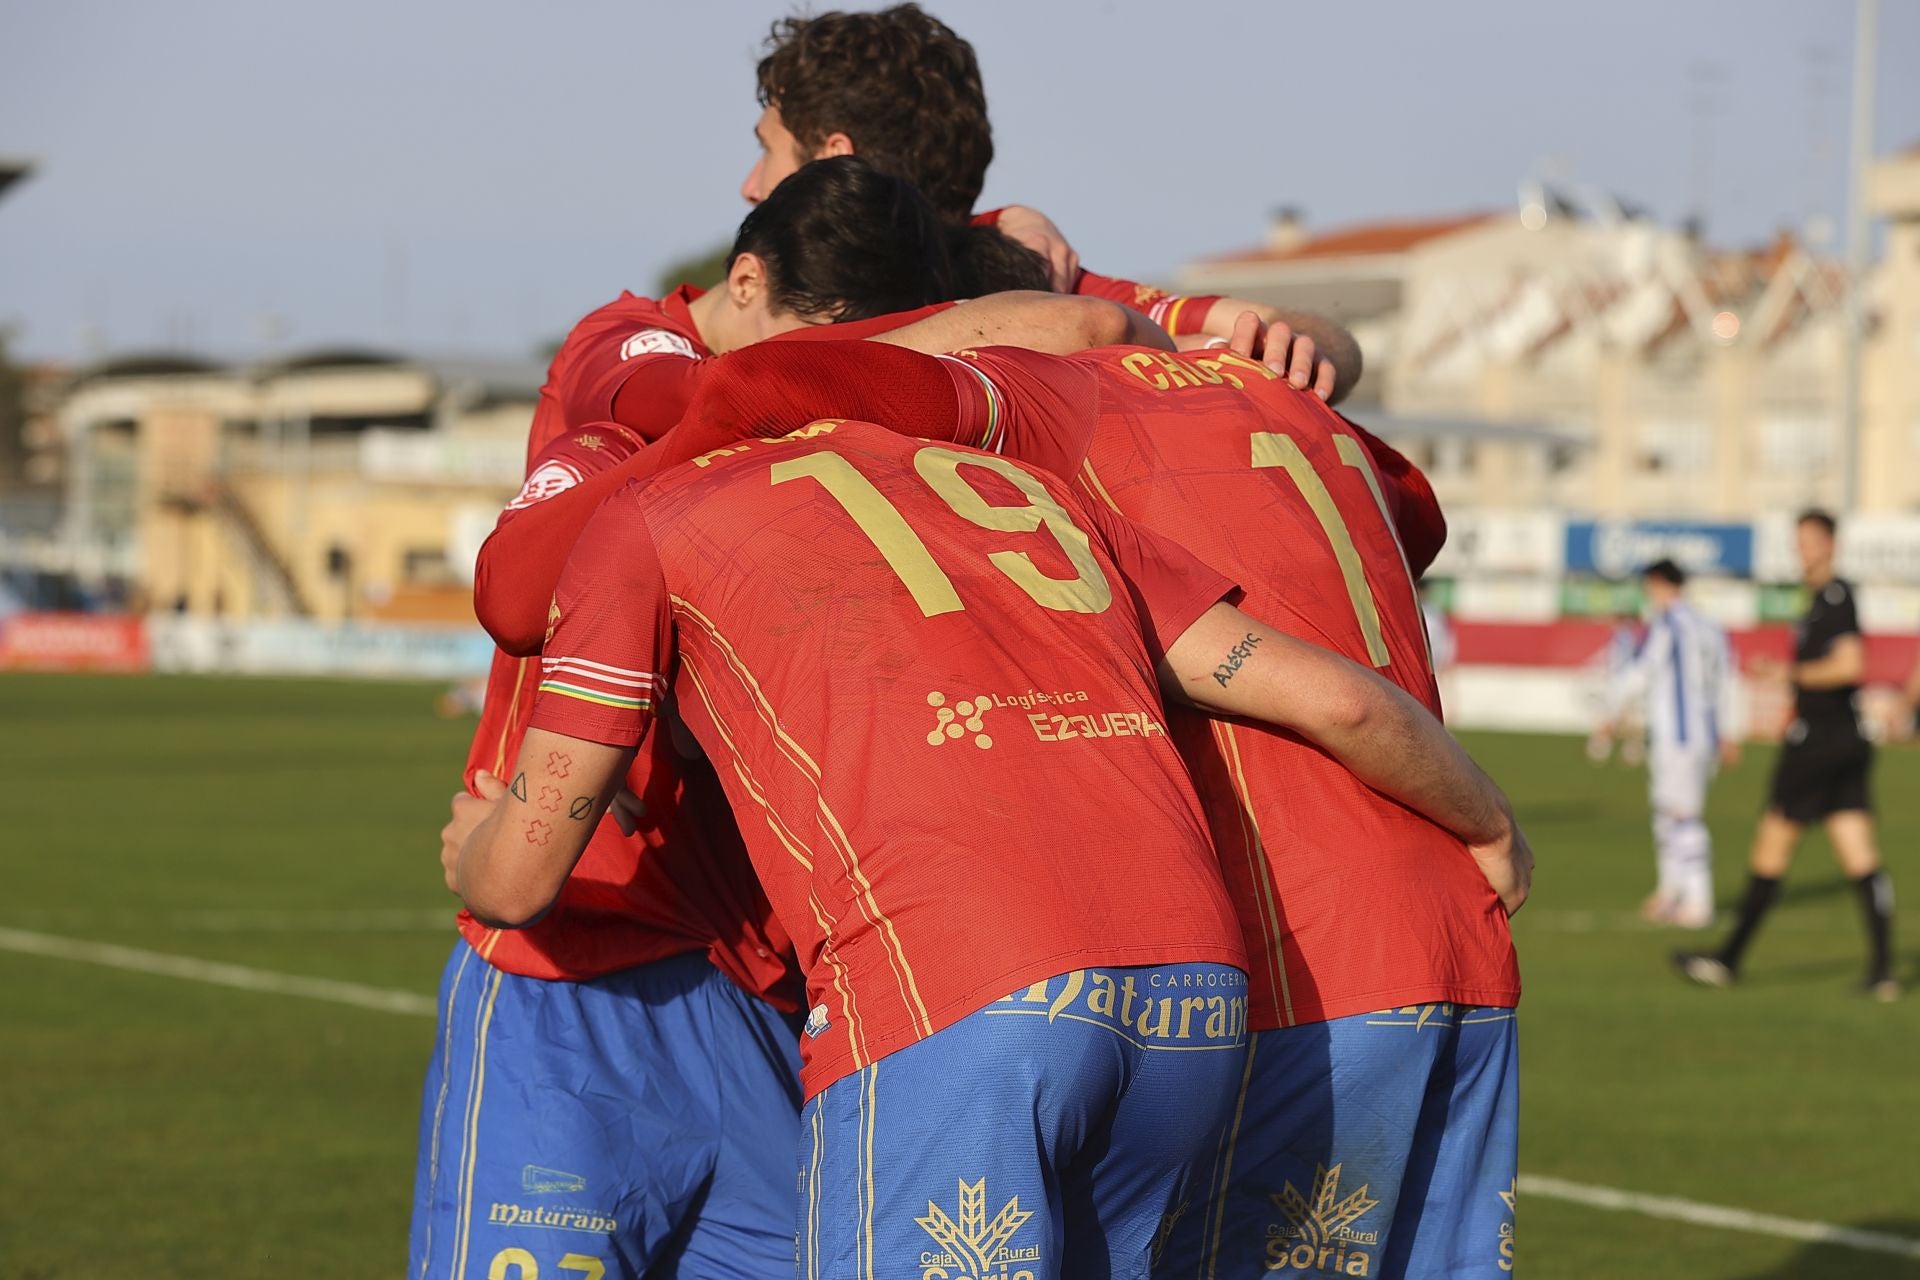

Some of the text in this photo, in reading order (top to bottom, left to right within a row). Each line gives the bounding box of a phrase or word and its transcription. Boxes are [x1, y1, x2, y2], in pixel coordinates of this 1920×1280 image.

[770, 446, 1112, 617] 19
[991, 688, 1089, 710] Logística
[1339, 1226, 1377, 1243] Rural
[920, 1244, 1039, 1266] Caja Rural
[1264, 1237, 1370, 1277] Soria
